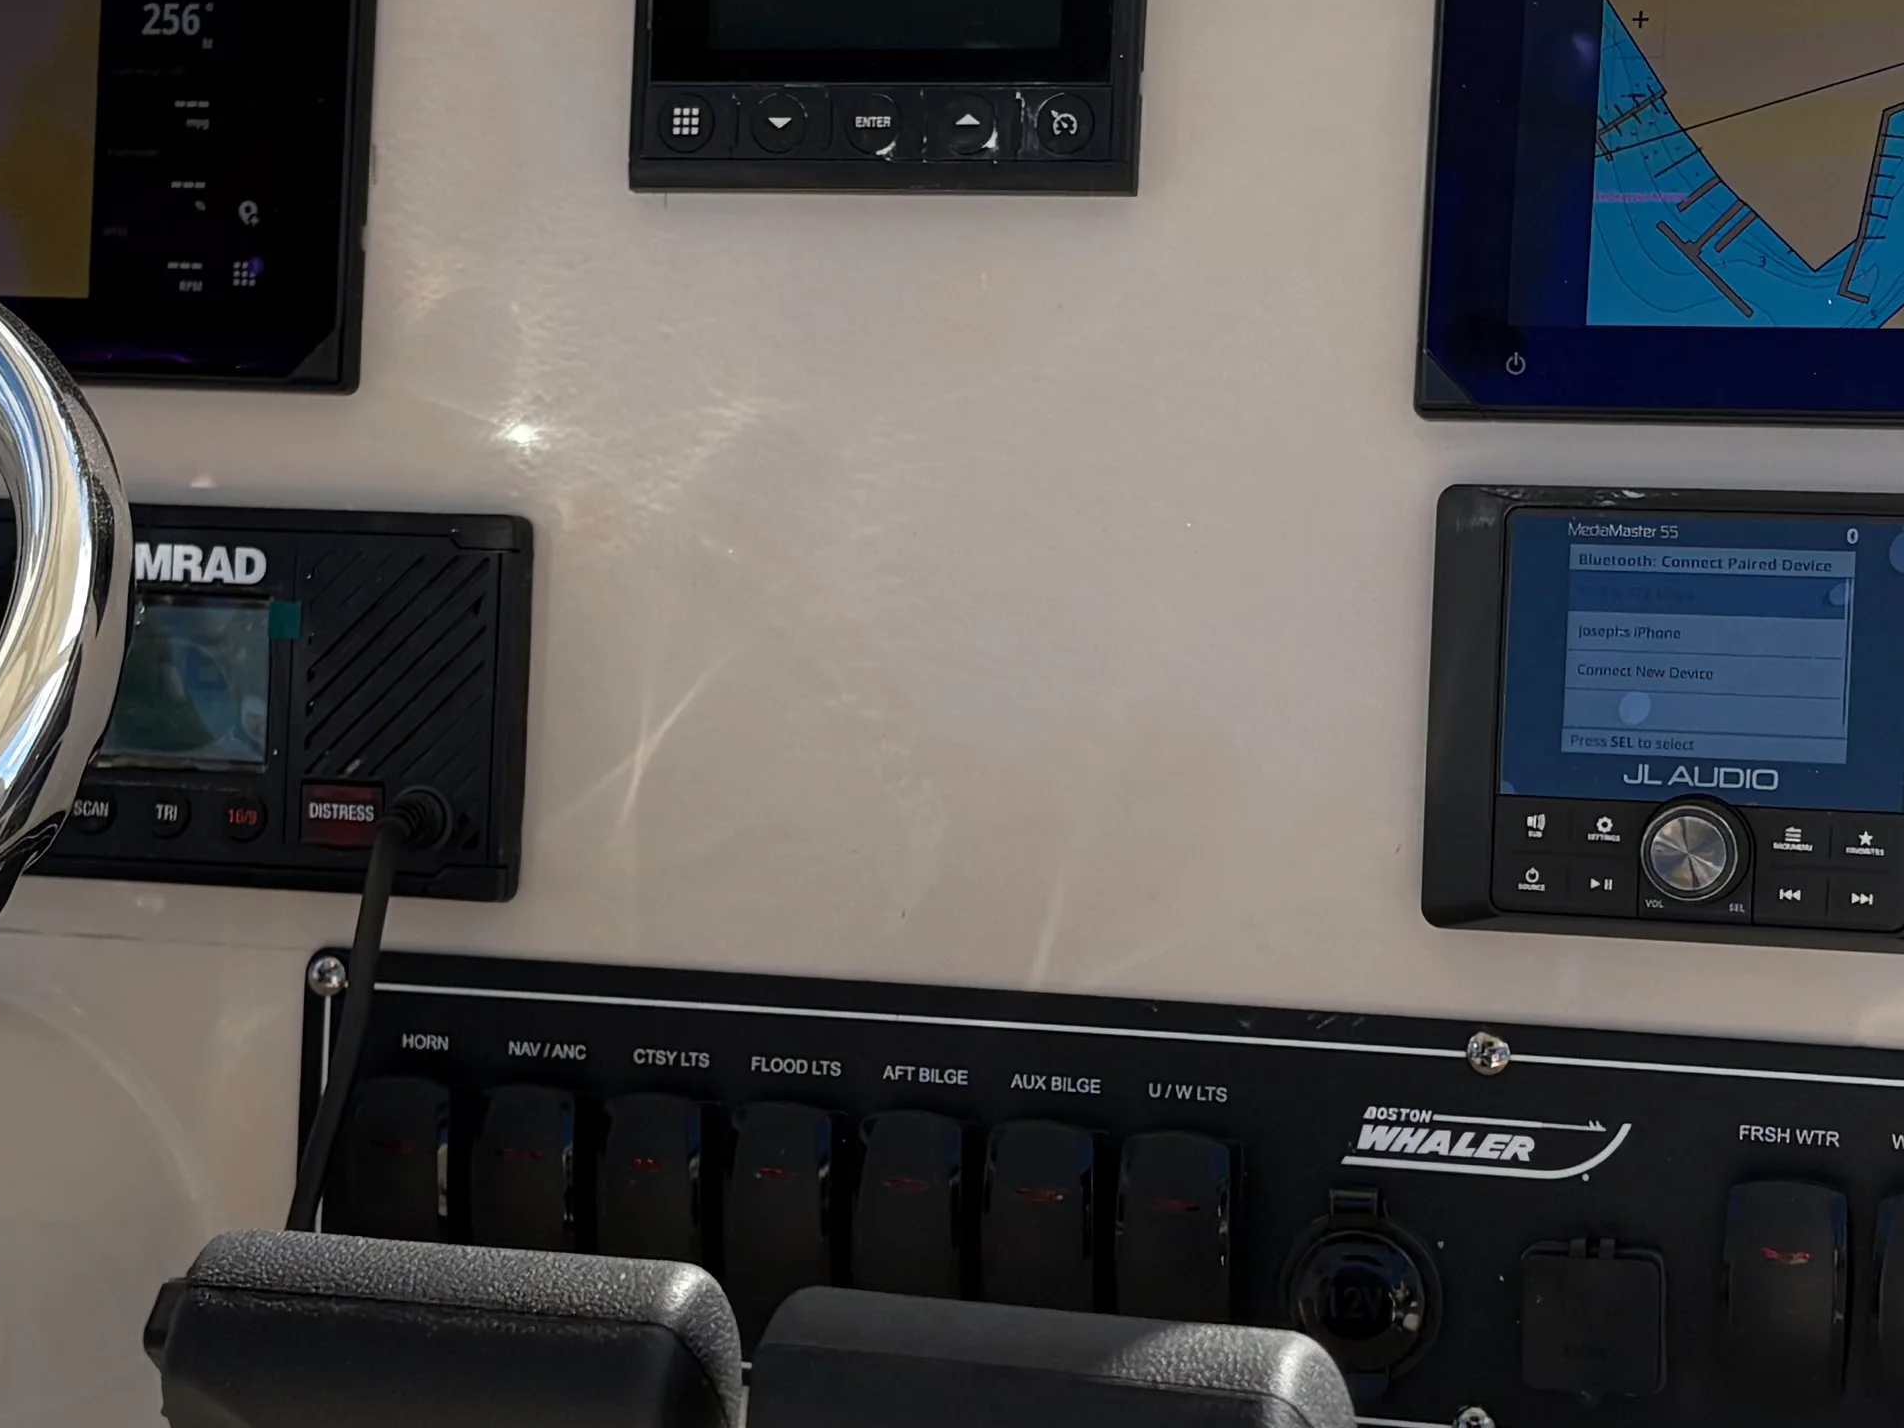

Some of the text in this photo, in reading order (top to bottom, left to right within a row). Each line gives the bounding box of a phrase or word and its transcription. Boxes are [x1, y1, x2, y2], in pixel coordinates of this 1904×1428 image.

[855, 115, 891, 129] ENTER
[178, 280, 203, 293] RPM
[1659, 525, 1679, 539] 55
[135, 541, 267, 585] MRAD
[1579, 553, 1832, 573] Bluetooth: Connect Paired Device
[1634, 626, 1681, 640] iPhone
[1577, 664, 1714, 681] Connect New Device
[1570, 735, 1694, 751] Press SEL to select
[1623, 763, 1780, 791] JL AUDIO
[73, 799, 375, 826] SCAN TRI 16/9 DISTRESS
[1645, 899, 1745, 914] VOL SEL
[401, 1032, 450, 1052] HORN
[507, 1040, 544, 1058] NAV
[551, 1042, 587, 1061] ANC
[633, 1048, 710, 1068] CTSY LTS
[751, 1056, 842, 1078] FLOOD LTS
[882, 1064, 969, 1086] AFT BILGE
[1010, 1073, 1101, 1095] AUX BILGE
[1148, 1082, 1163, 1099] U
[1174, 1083, 1194, 1100] W
[1195, 1085, 1228, 1103] LTS
[1362, 1106, 1433, 1124] BOSTON
[1356, 1123, 1536, 1162] WHALER
[1738, 1124, 1840, 1148] FRSH WTR
[1328, 1283, 1387, 1319] 12V
